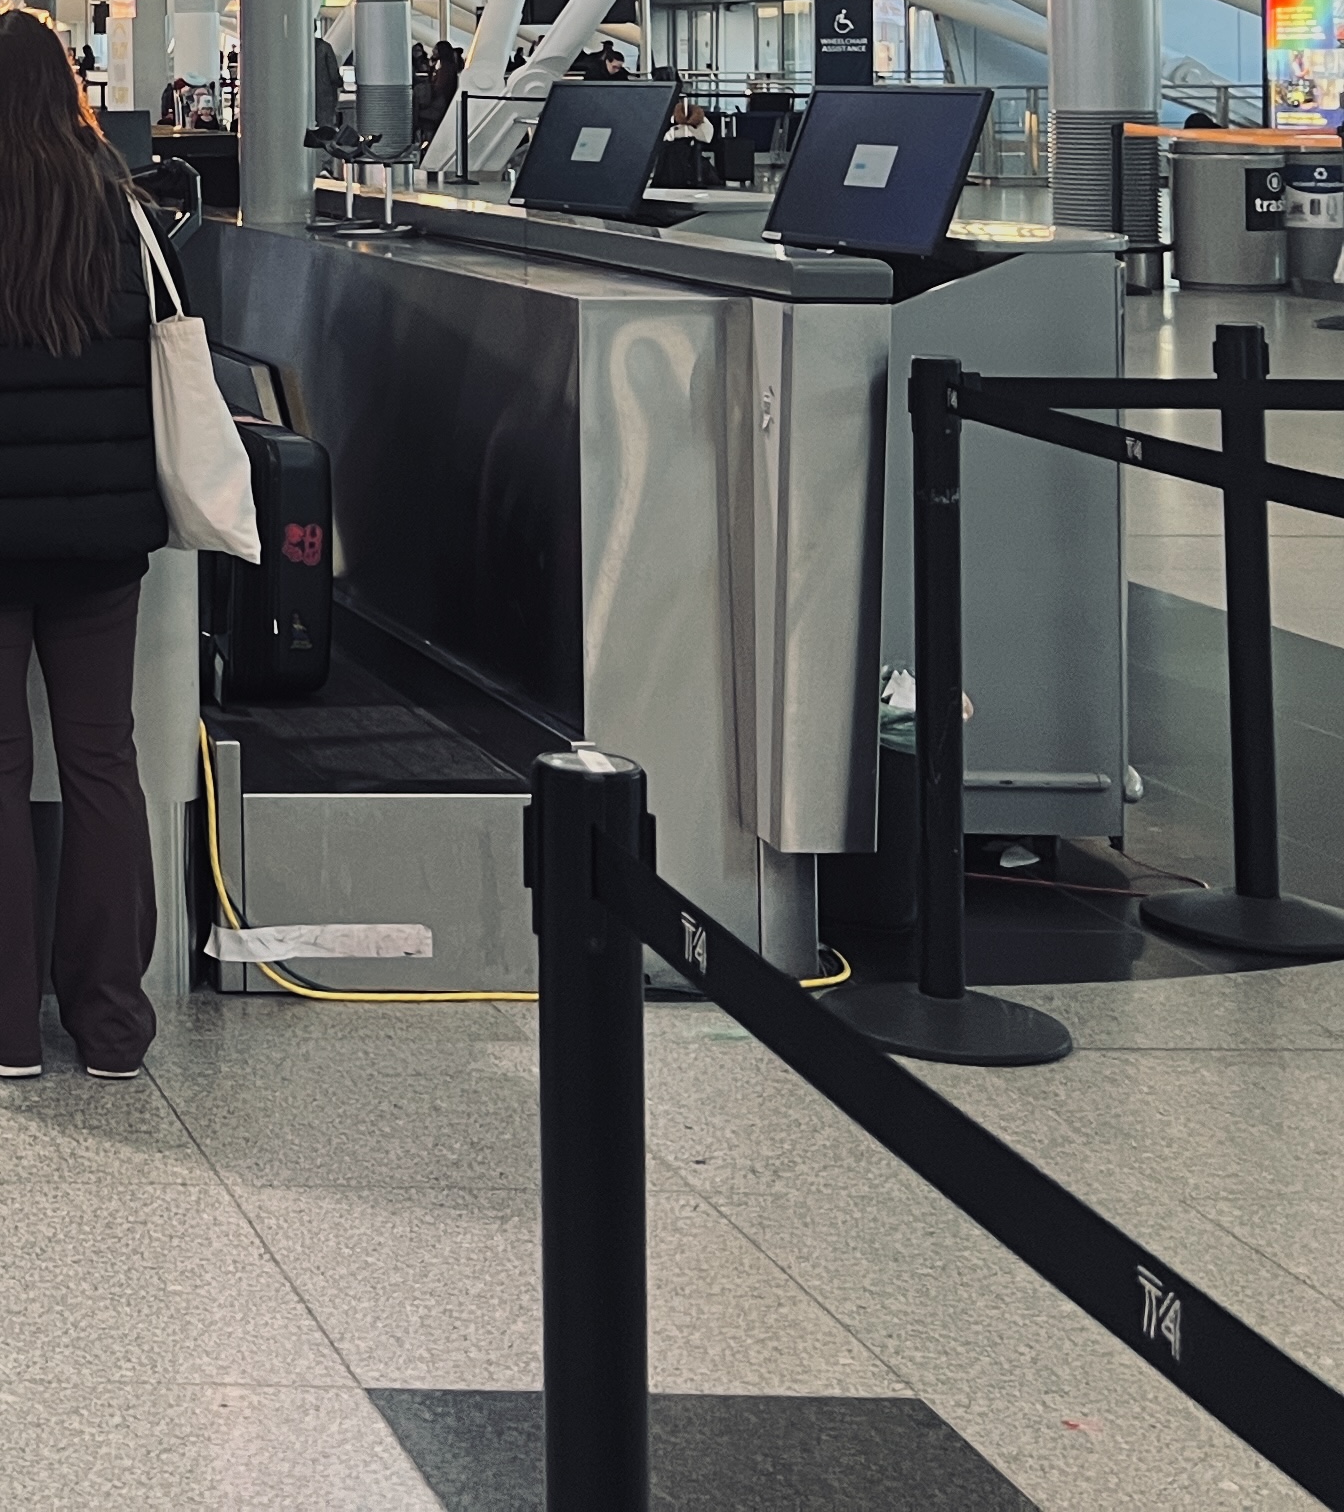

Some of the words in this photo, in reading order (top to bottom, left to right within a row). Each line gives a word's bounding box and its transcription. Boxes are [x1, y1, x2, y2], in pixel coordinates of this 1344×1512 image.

[1255, 198, 1285, 213] tras
[681, 911, 707, 976] T4
[1137, 1265, 1181, 1361] T4
